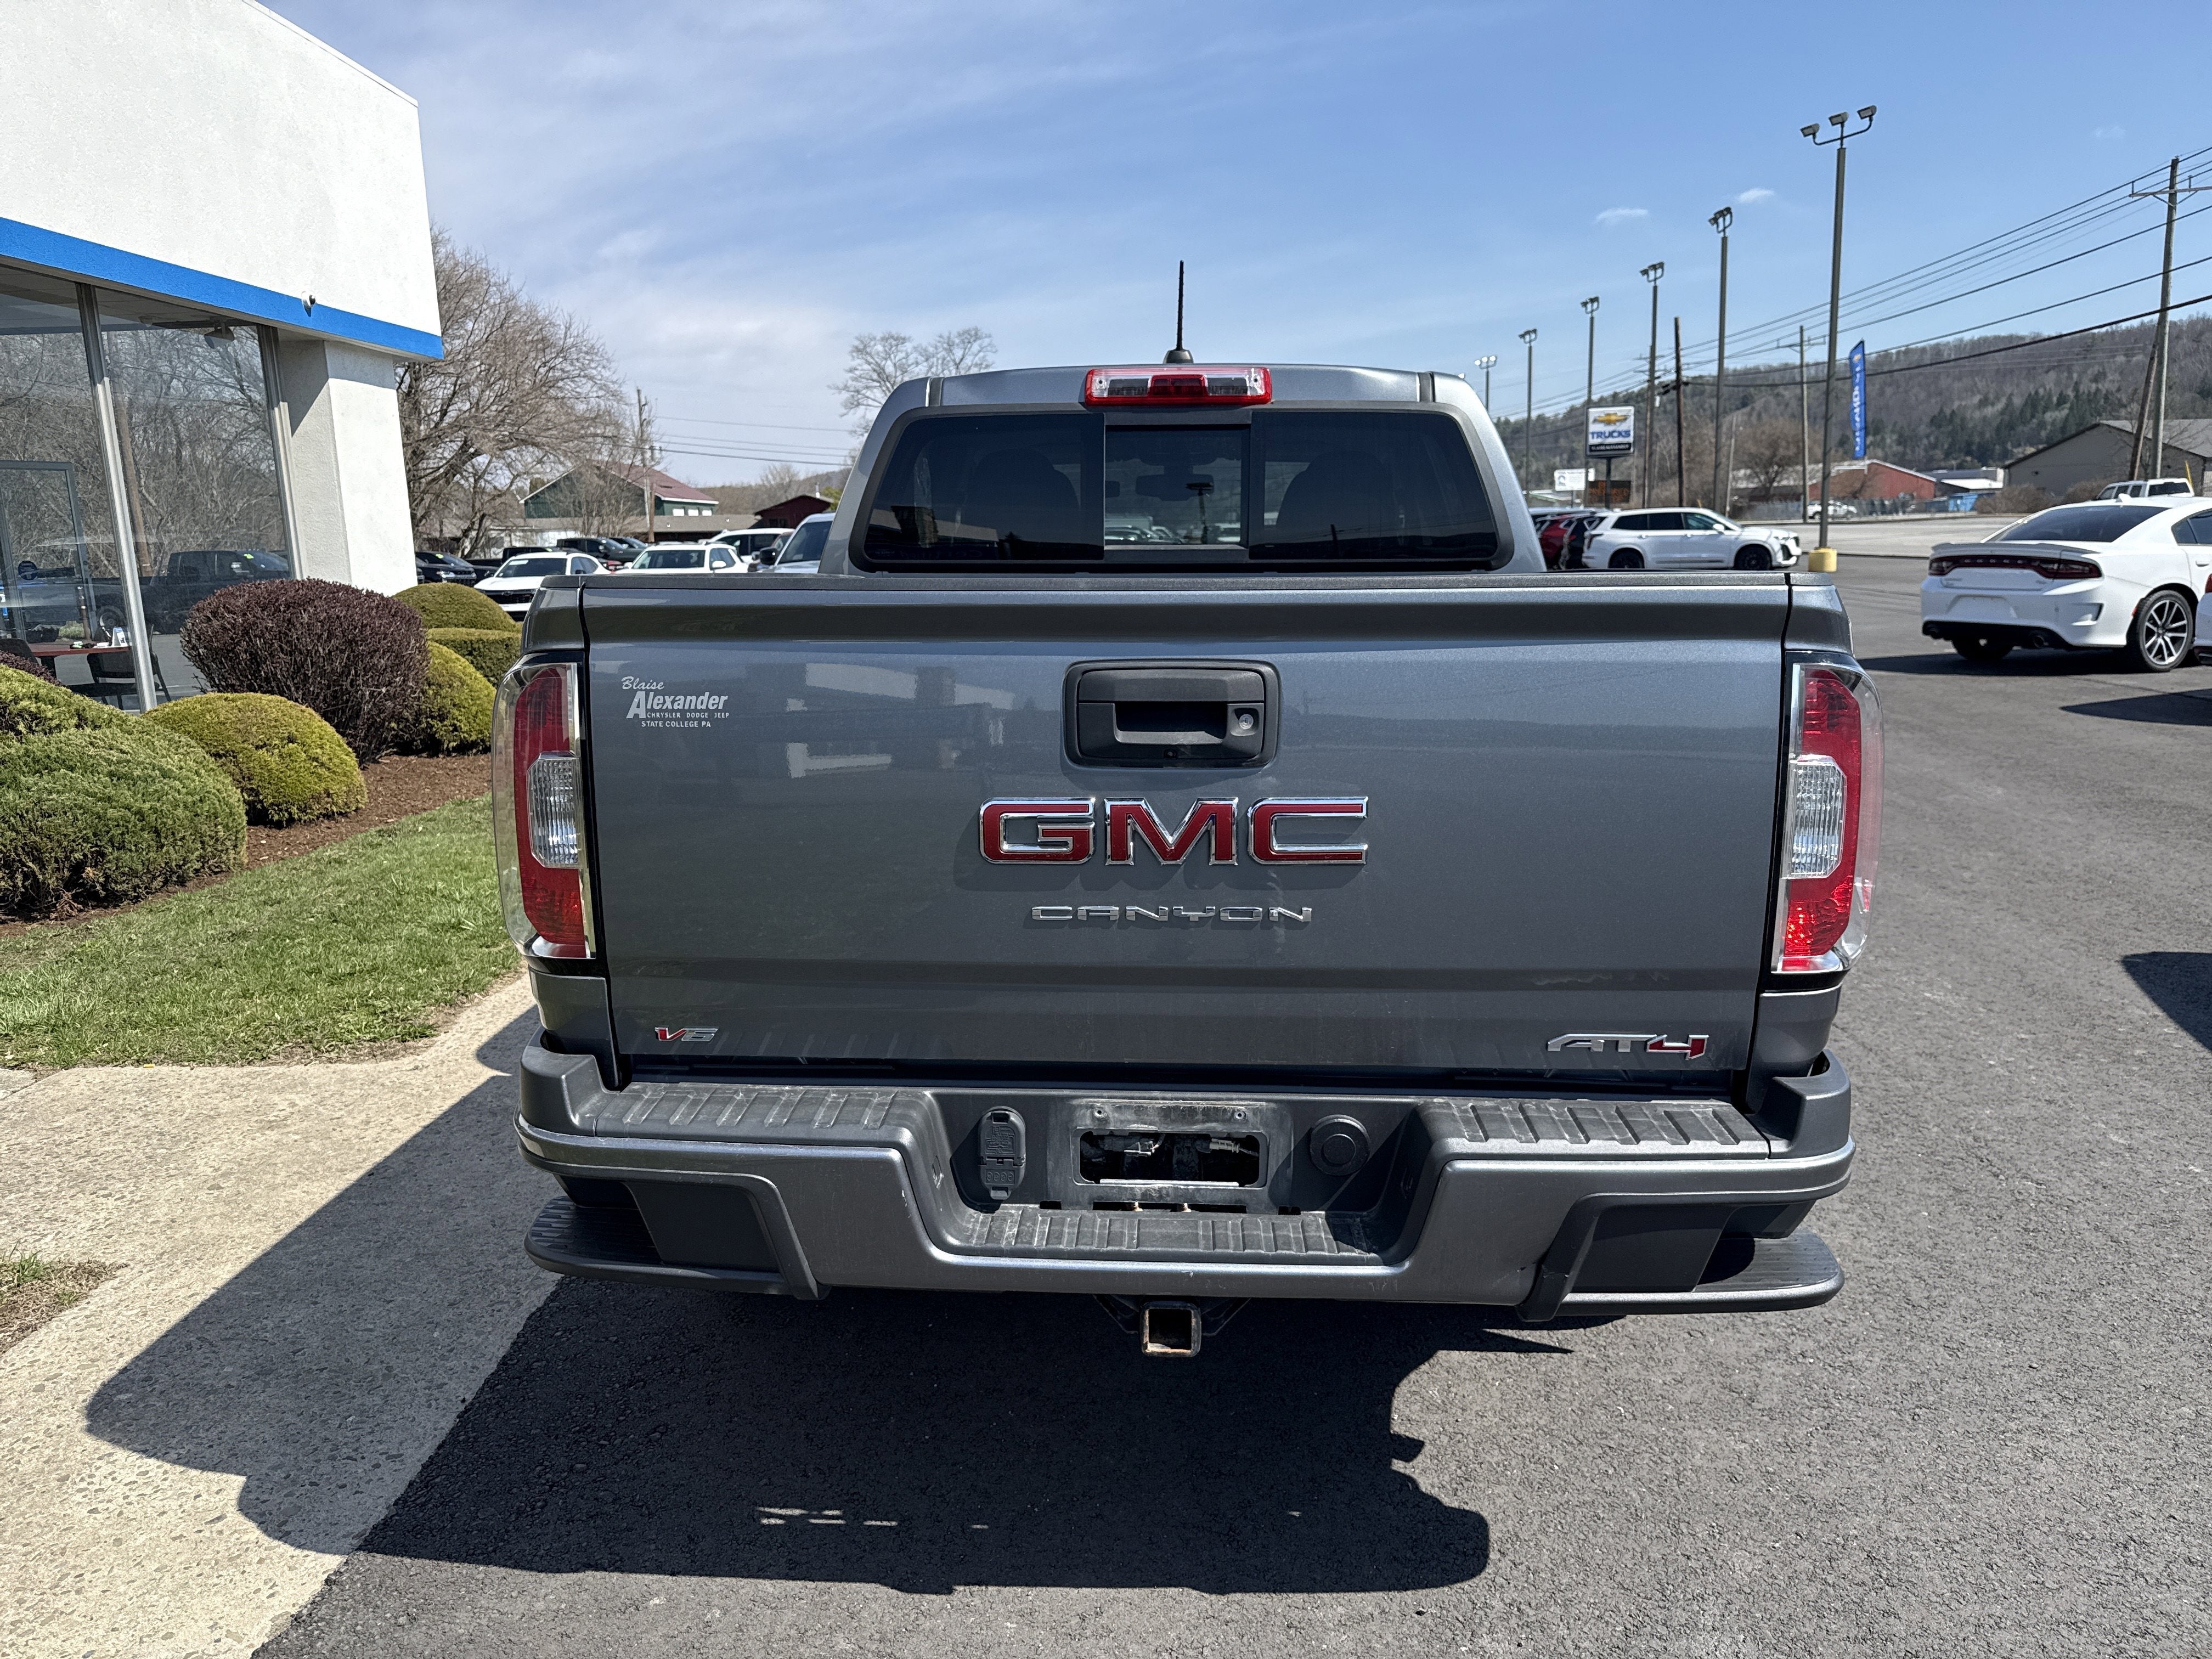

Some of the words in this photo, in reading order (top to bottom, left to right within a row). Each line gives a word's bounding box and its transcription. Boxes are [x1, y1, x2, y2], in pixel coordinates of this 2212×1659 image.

[1590, 430, 1630, 439] TRUCKS
[621, 676, 664, 690] Blaise
[626, 691, 728, 719] Alexander
[979, 797, 1368, 865] GMC
[1031, 905, 1312, 922] CANYON
[654, 1026, 719, 1042] V6
[1547, 1034, 1709, 1060] AT4
